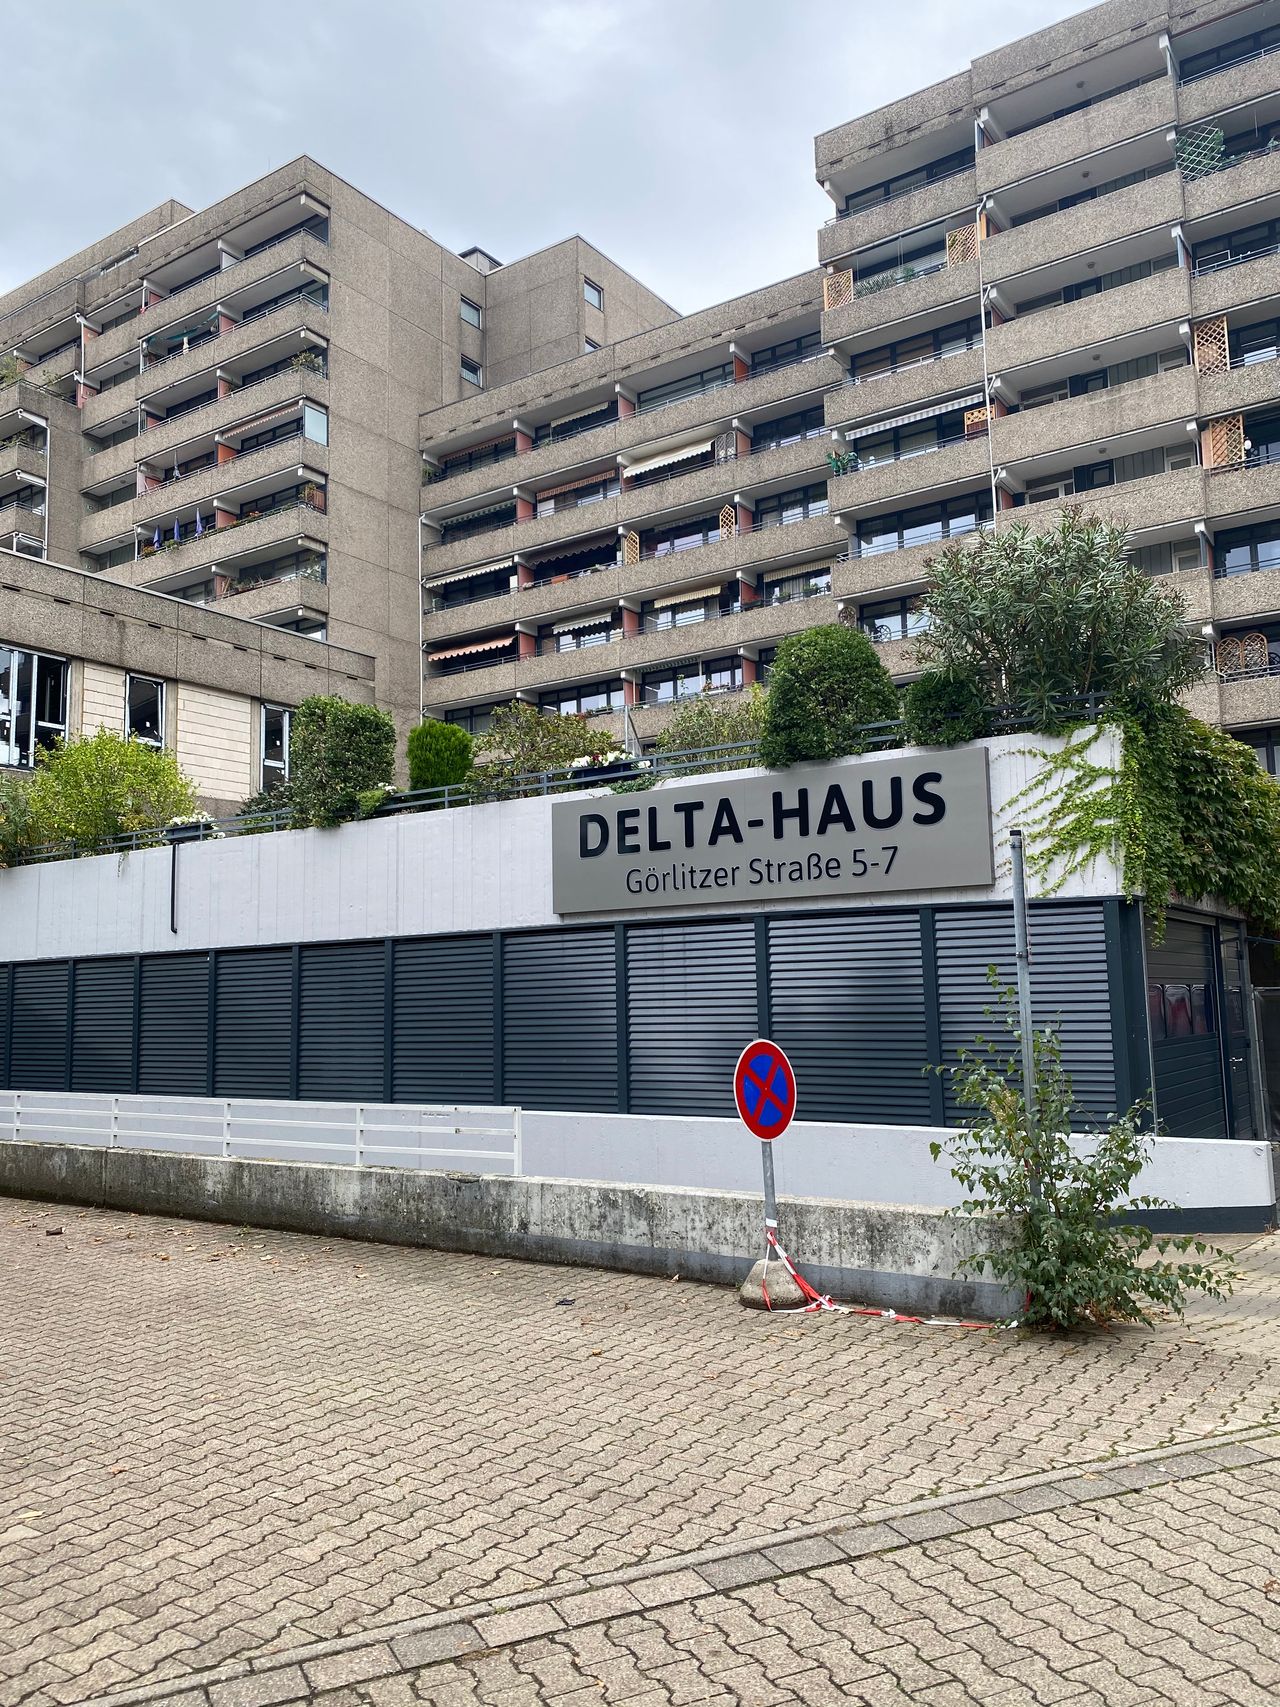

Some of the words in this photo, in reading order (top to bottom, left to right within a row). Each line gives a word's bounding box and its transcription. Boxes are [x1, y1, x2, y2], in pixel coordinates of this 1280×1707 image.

[579, 771, 947, 859] DELTA-HAUS
[625, 863, 741, 894] Görlitzer
[748, 852, 841, 885] Straße
[851, 845, 900, 877] 5-7
